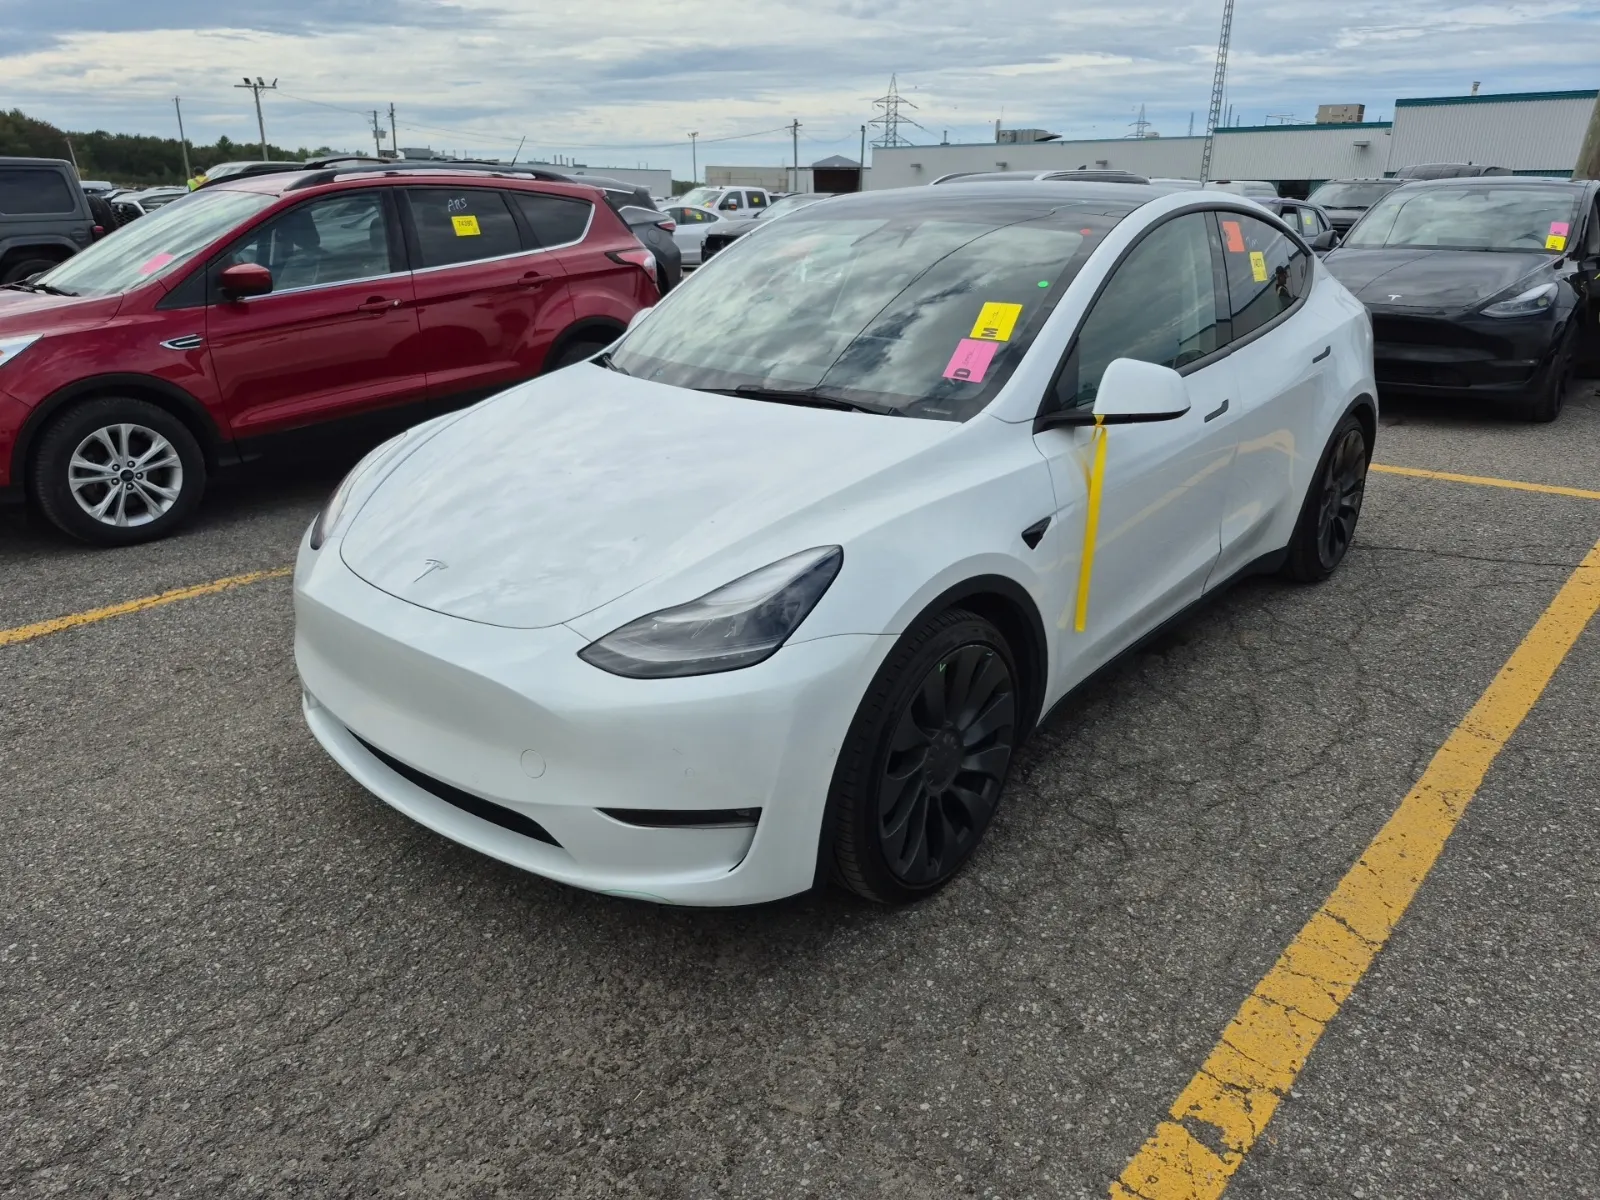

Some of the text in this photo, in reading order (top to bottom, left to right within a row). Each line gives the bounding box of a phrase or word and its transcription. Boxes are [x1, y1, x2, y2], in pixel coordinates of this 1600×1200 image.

[448, 198, 467, 212] ARS
[981, 327, 999, 338] M
[954, 368, 971, 378] D
